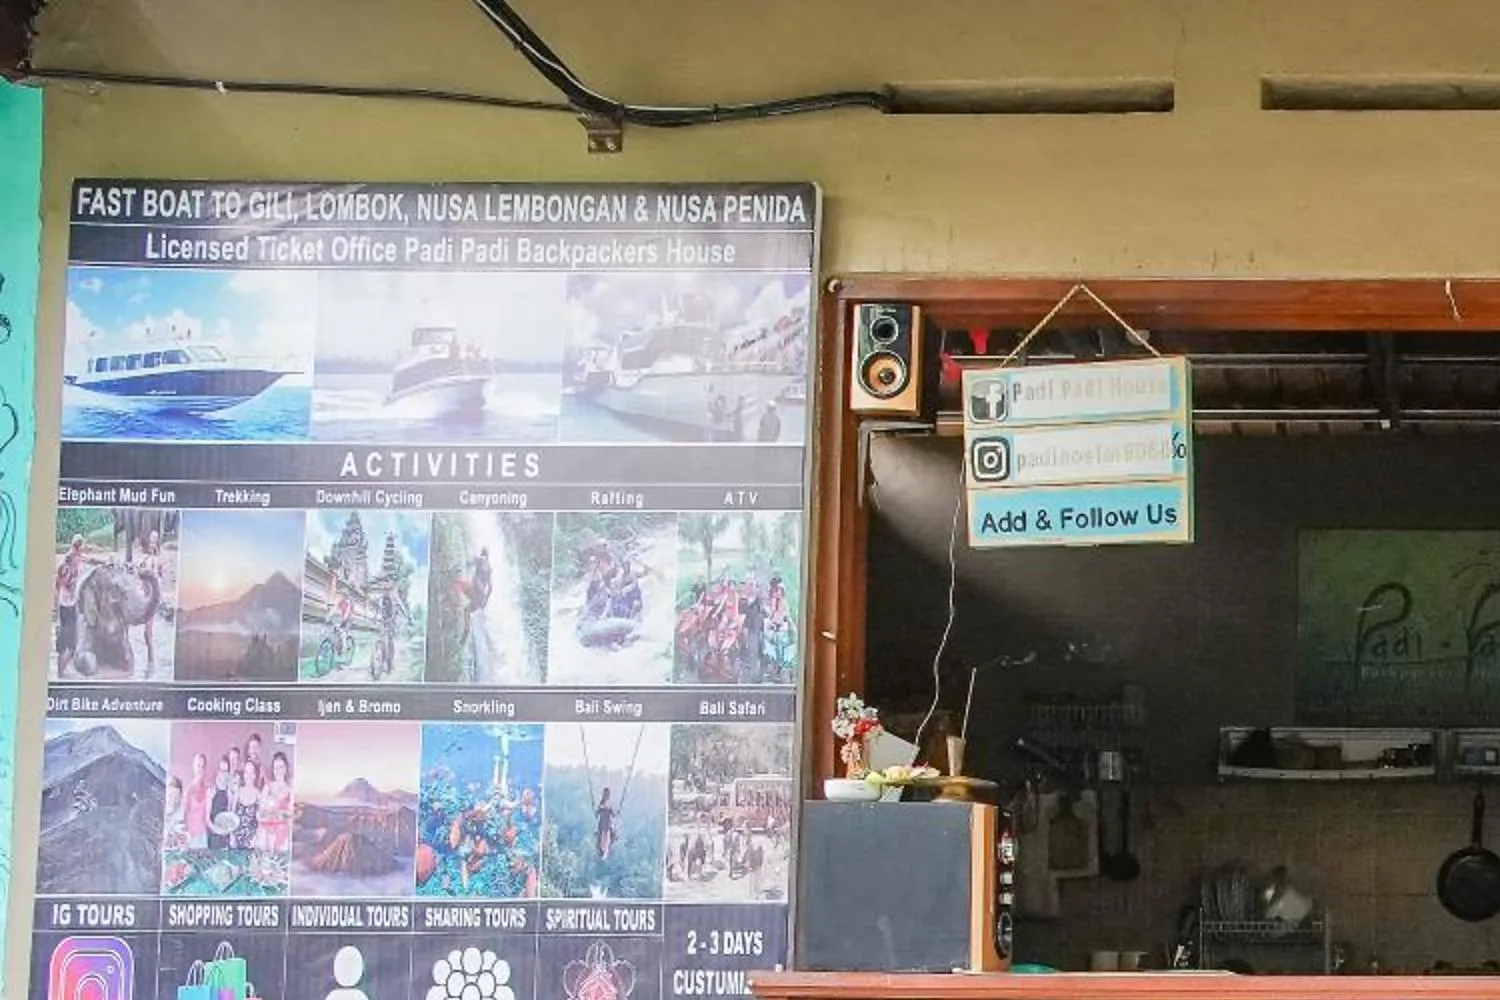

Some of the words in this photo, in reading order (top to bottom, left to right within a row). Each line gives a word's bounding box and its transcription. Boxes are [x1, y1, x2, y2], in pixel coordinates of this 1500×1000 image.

[77, 187, 137, 217] FAST
[142, 188, 205, 219] BOAT
[211, 190, 242, 219] TO
[307, 192, 409, 225] LOMBOK,
[417, 192, 478, 222] NUSA
[485, 193, 628, 223] LEMBONGAN
[633, 194, 649, 223] &
[656, 194, 717, 223] NUSA
[724, 194, 806, 224] PENIDA
[145, 233, 249, 261] Licensed
[257, 235, 324, 262] Ticket
[331, 235, 397, 263] Office
[404, 236, 453, 263] Padi
[461, 237, 509, 264] Padi
[517, 238, 658, 269] Backpackers
[667, 240, 736, 264] House
[340, 451, 541, 478] ACTIVITIES
[58, 486, 117, 504] Elephant
[119, 488, 148, 503] Mud
[151, 489, 176, 503] Fun
[215, 489, 271, 506] Trekking
[316, 489, 371, 505] Downhill
[375, 490, 424, 508] Cycling
[459, 490, 528, 508] Canyoning
[591, 490, 644, 508] Rafting
[981, 511, 1027, 533] Add
[1035, 509, 1053, 531] &
[1060, 507, 1139, 530] Follow
[1146, 503, 1178, 525] Us
[71, 697, 99, 711] Bike
[102, 698, 164, 712] Adventure
[187, 697, 241, 714] Cooking
[245, 697, 282, 713] Class
[345, 700, 355, 714] &
[359, 699, 402, 714] Bromo
[453, 699, 515, 717] Snorkling
[575, 699, 600, 714] Bali
[603, 700, 643, 717] Swing
[699, 700, 726, 715] Bali
[729, 700, 766, 715] Safari
[52, 904, 71, 925] IG
[76, 904, 136, 926] TOURS
[169, 905, 233, 926] SHOPPING
[236, 905, 279, 926] TOURS
[291, 905, 364, 927] INDIVIDUAL
[367, 906, 409, 927] TOURS
[425, 906, 481, 928] SHARING
[485, 907, 527, 928] TOURS
[545, 908, 611, 931] SPIRITUAL
[614, 909, 656, 931] TOURS
[687, 931, 697, 955] 2
[710, 931, 720, 955] 3
[723, 931, 763, 956] DAYS
